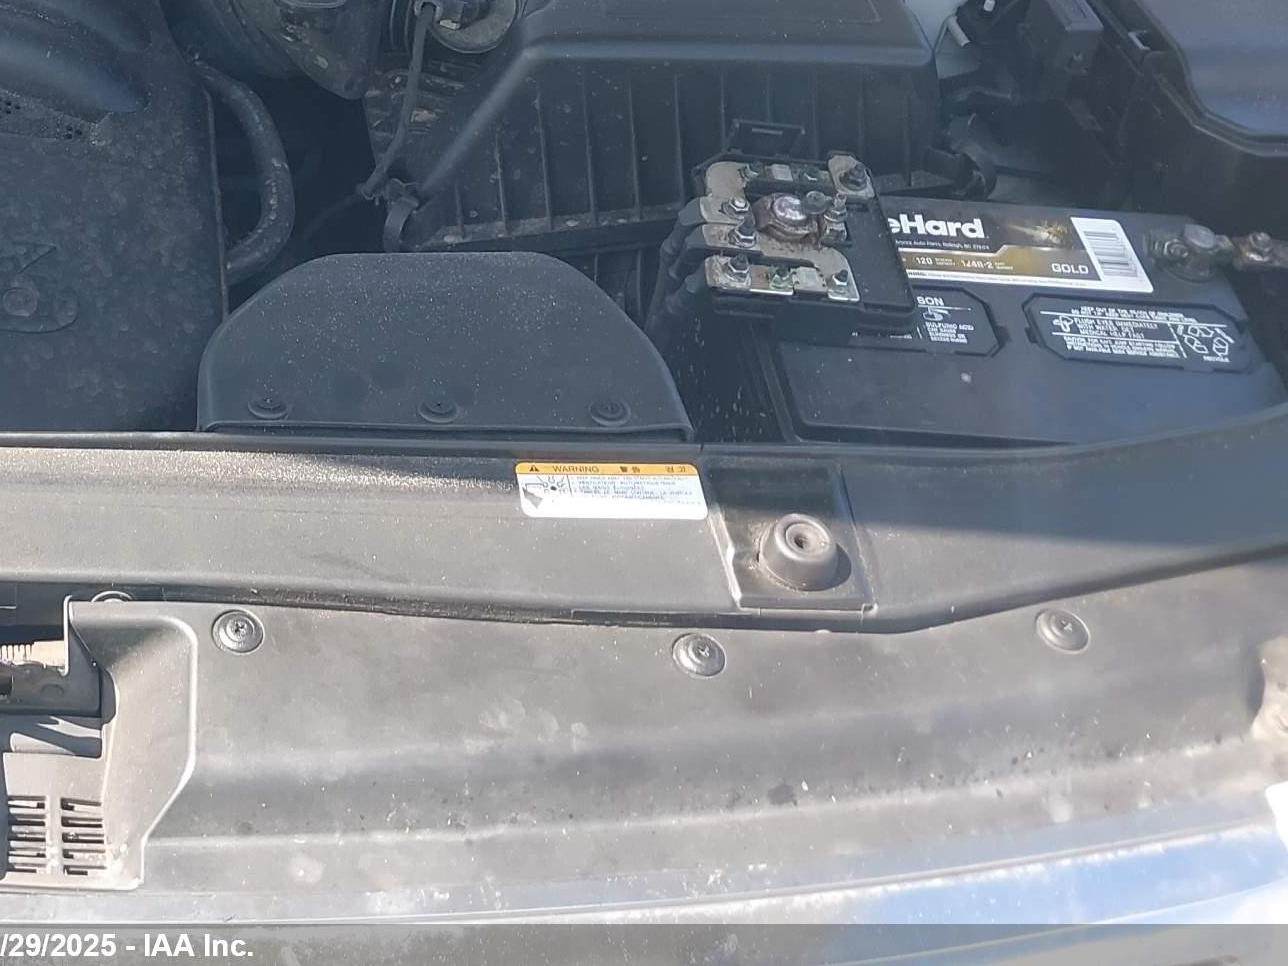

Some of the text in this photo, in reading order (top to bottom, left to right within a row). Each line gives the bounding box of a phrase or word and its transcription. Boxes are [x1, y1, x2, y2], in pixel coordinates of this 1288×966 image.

[887, 213, 986, 239] eHard
[916, 256, 933, 266] 120
[1051, 263, 1089, 274] GOLD
[916, 296, 945, 306] SON
